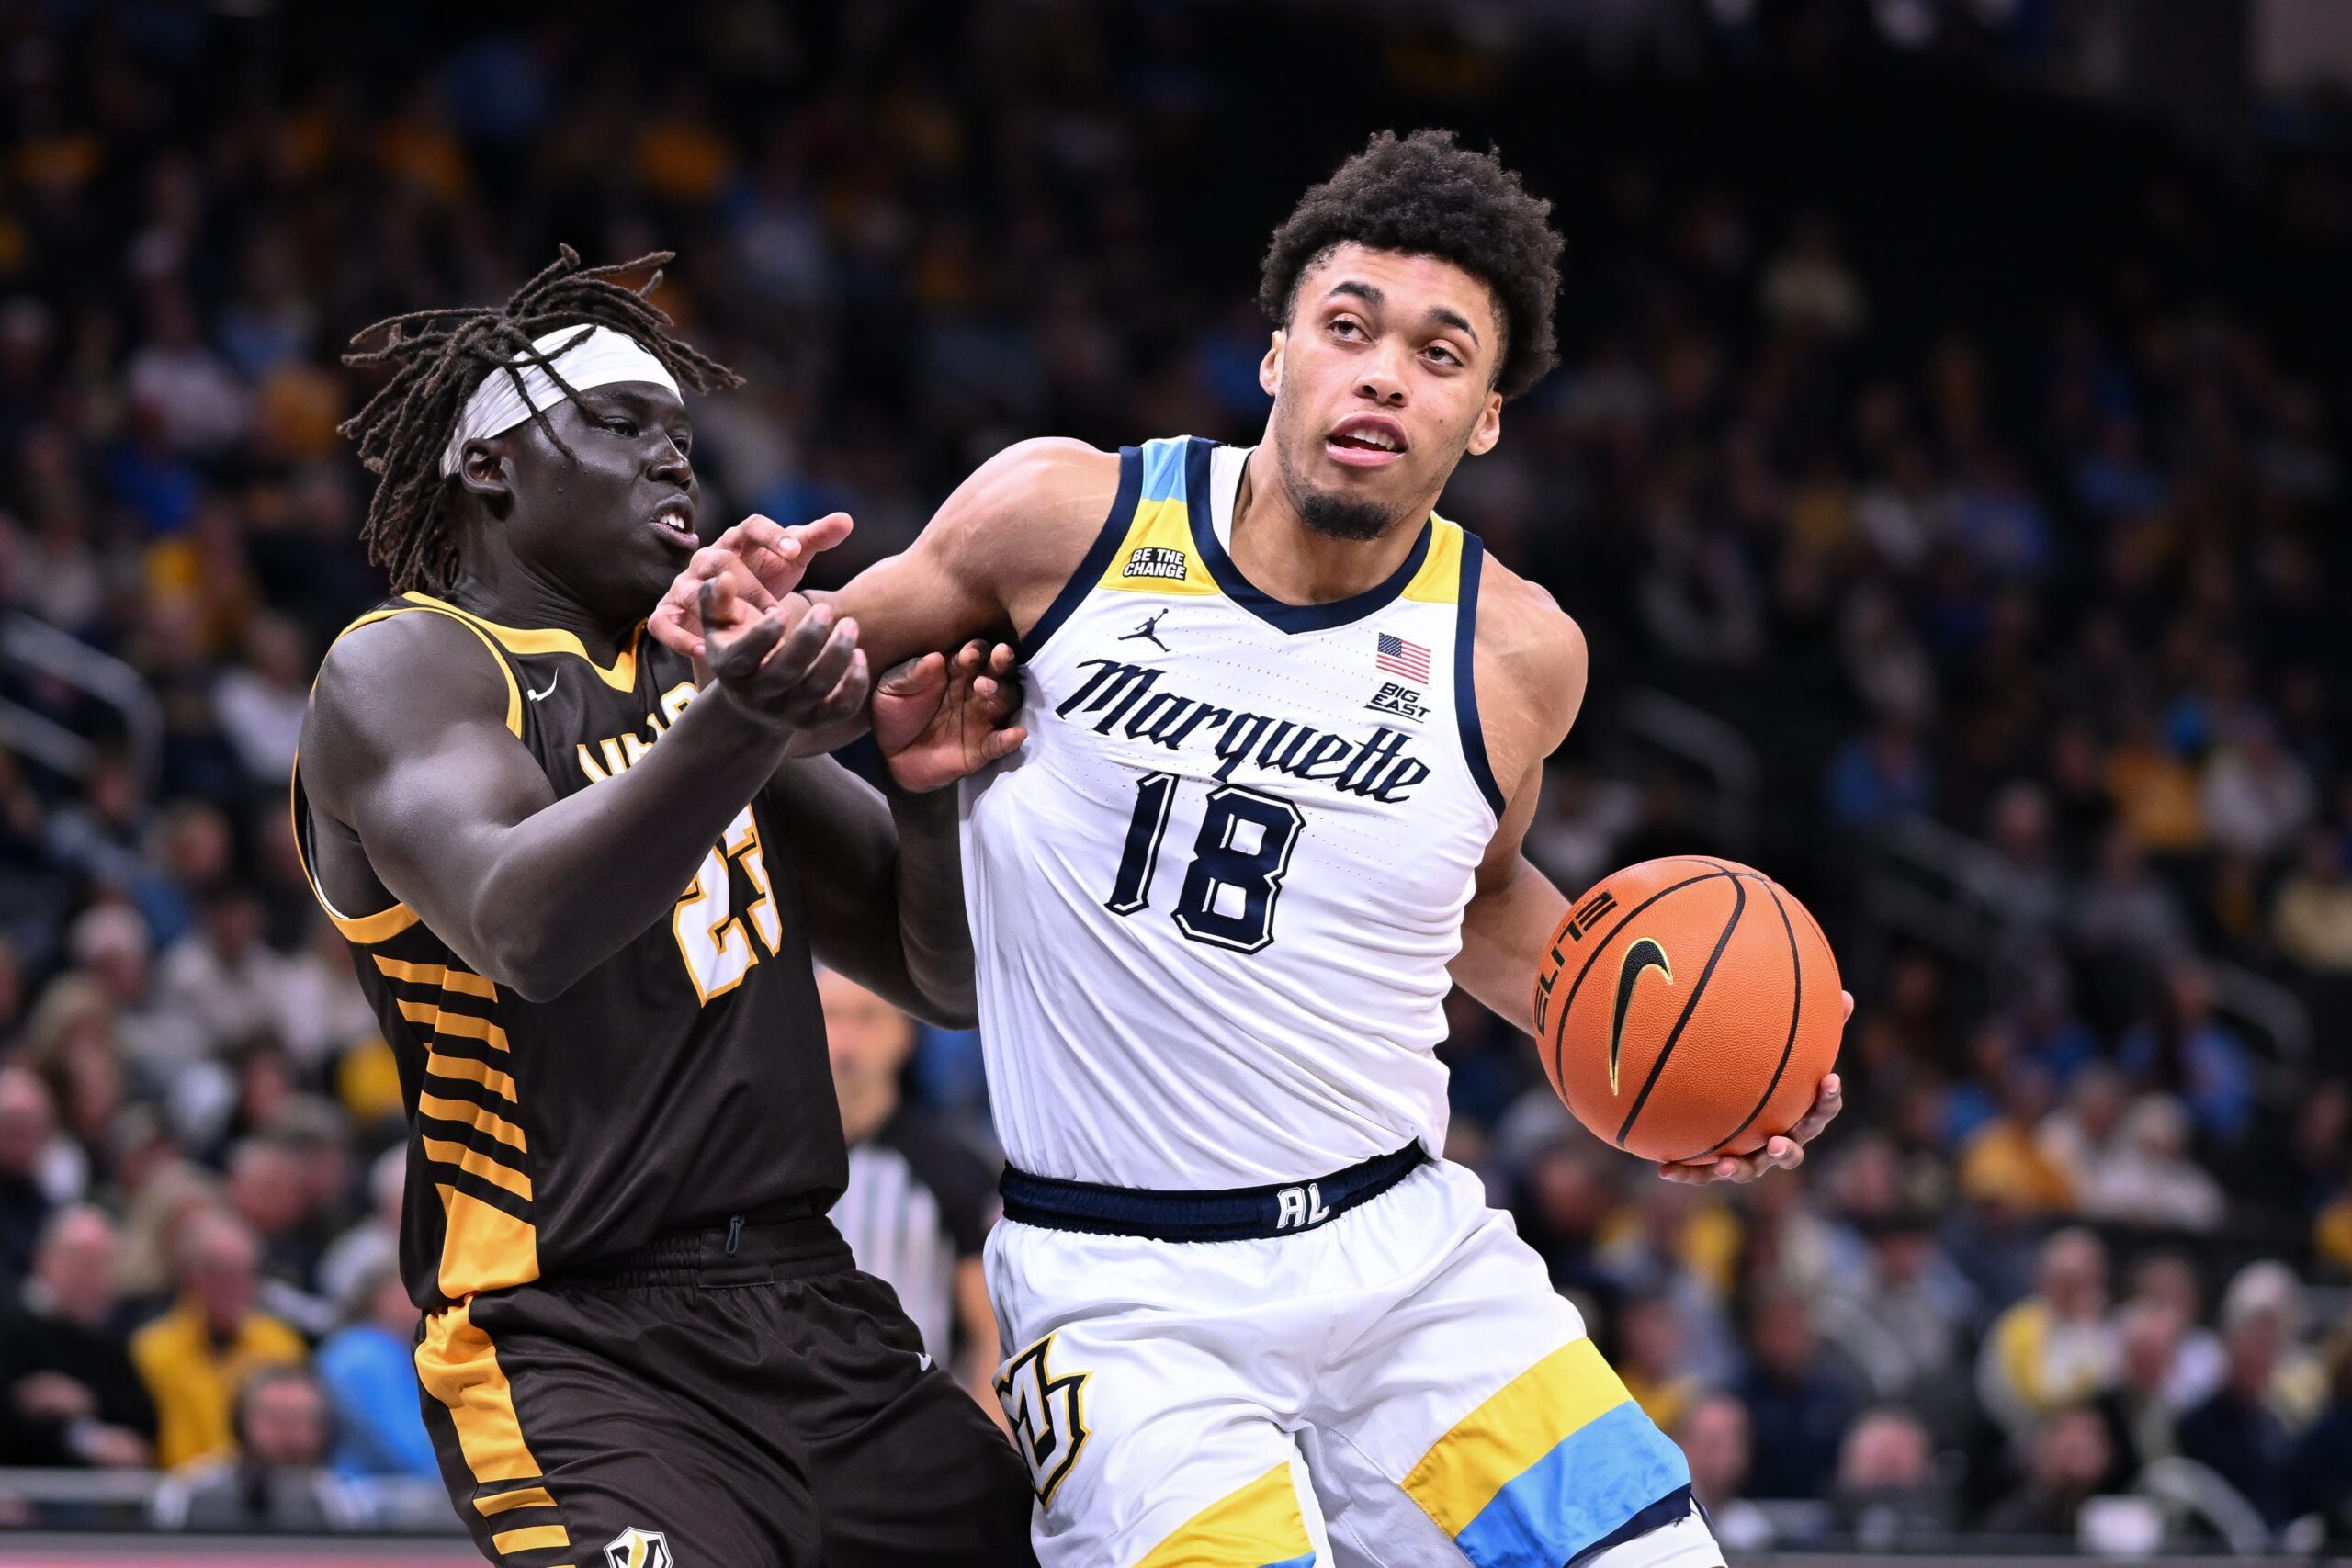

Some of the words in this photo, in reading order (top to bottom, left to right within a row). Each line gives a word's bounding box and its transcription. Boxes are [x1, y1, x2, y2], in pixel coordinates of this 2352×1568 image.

[1123, 561, 1187, 580] CHANGE
[1131, 547, 1153, 563] BE
[1157, 548, 1185, 566] THE
[1370, 693, 1431, 718] EAST
[1378, 682, 1422, 703] BIG
[1055, 659, 1431, 805] Marquette
[1103, 771, 1306, 956] 18
[1533, 889, 1619, 1038] ELITE
[1275, 1182, 1330, 1229] AL
